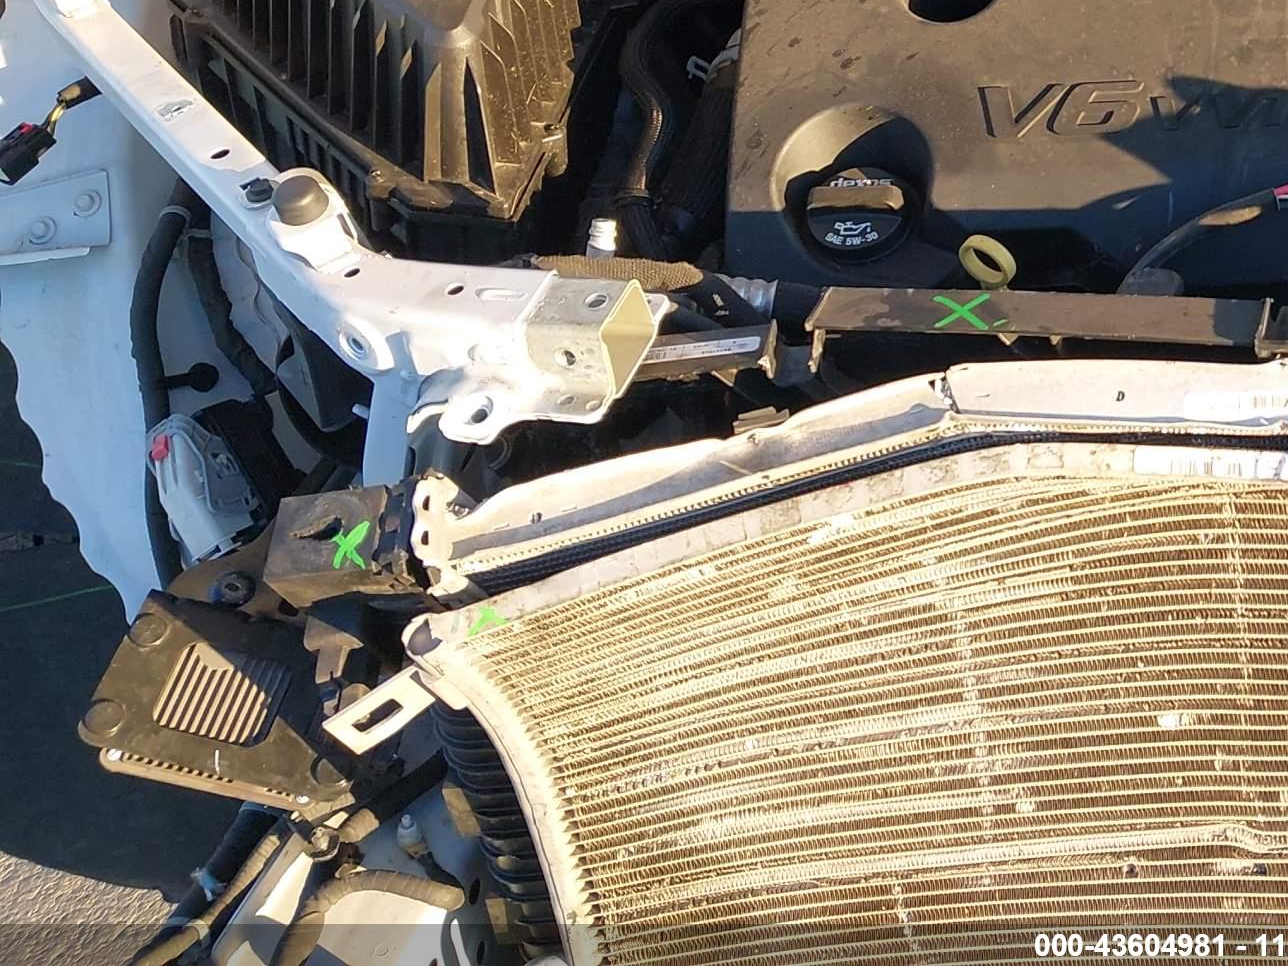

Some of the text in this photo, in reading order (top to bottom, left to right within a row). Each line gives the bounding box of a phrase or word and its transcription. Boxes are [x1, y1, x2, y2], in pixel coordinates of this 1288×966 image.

[977, 80, 1144, 139] V6
[825, 231, 879, 246] SAE 5W-30
